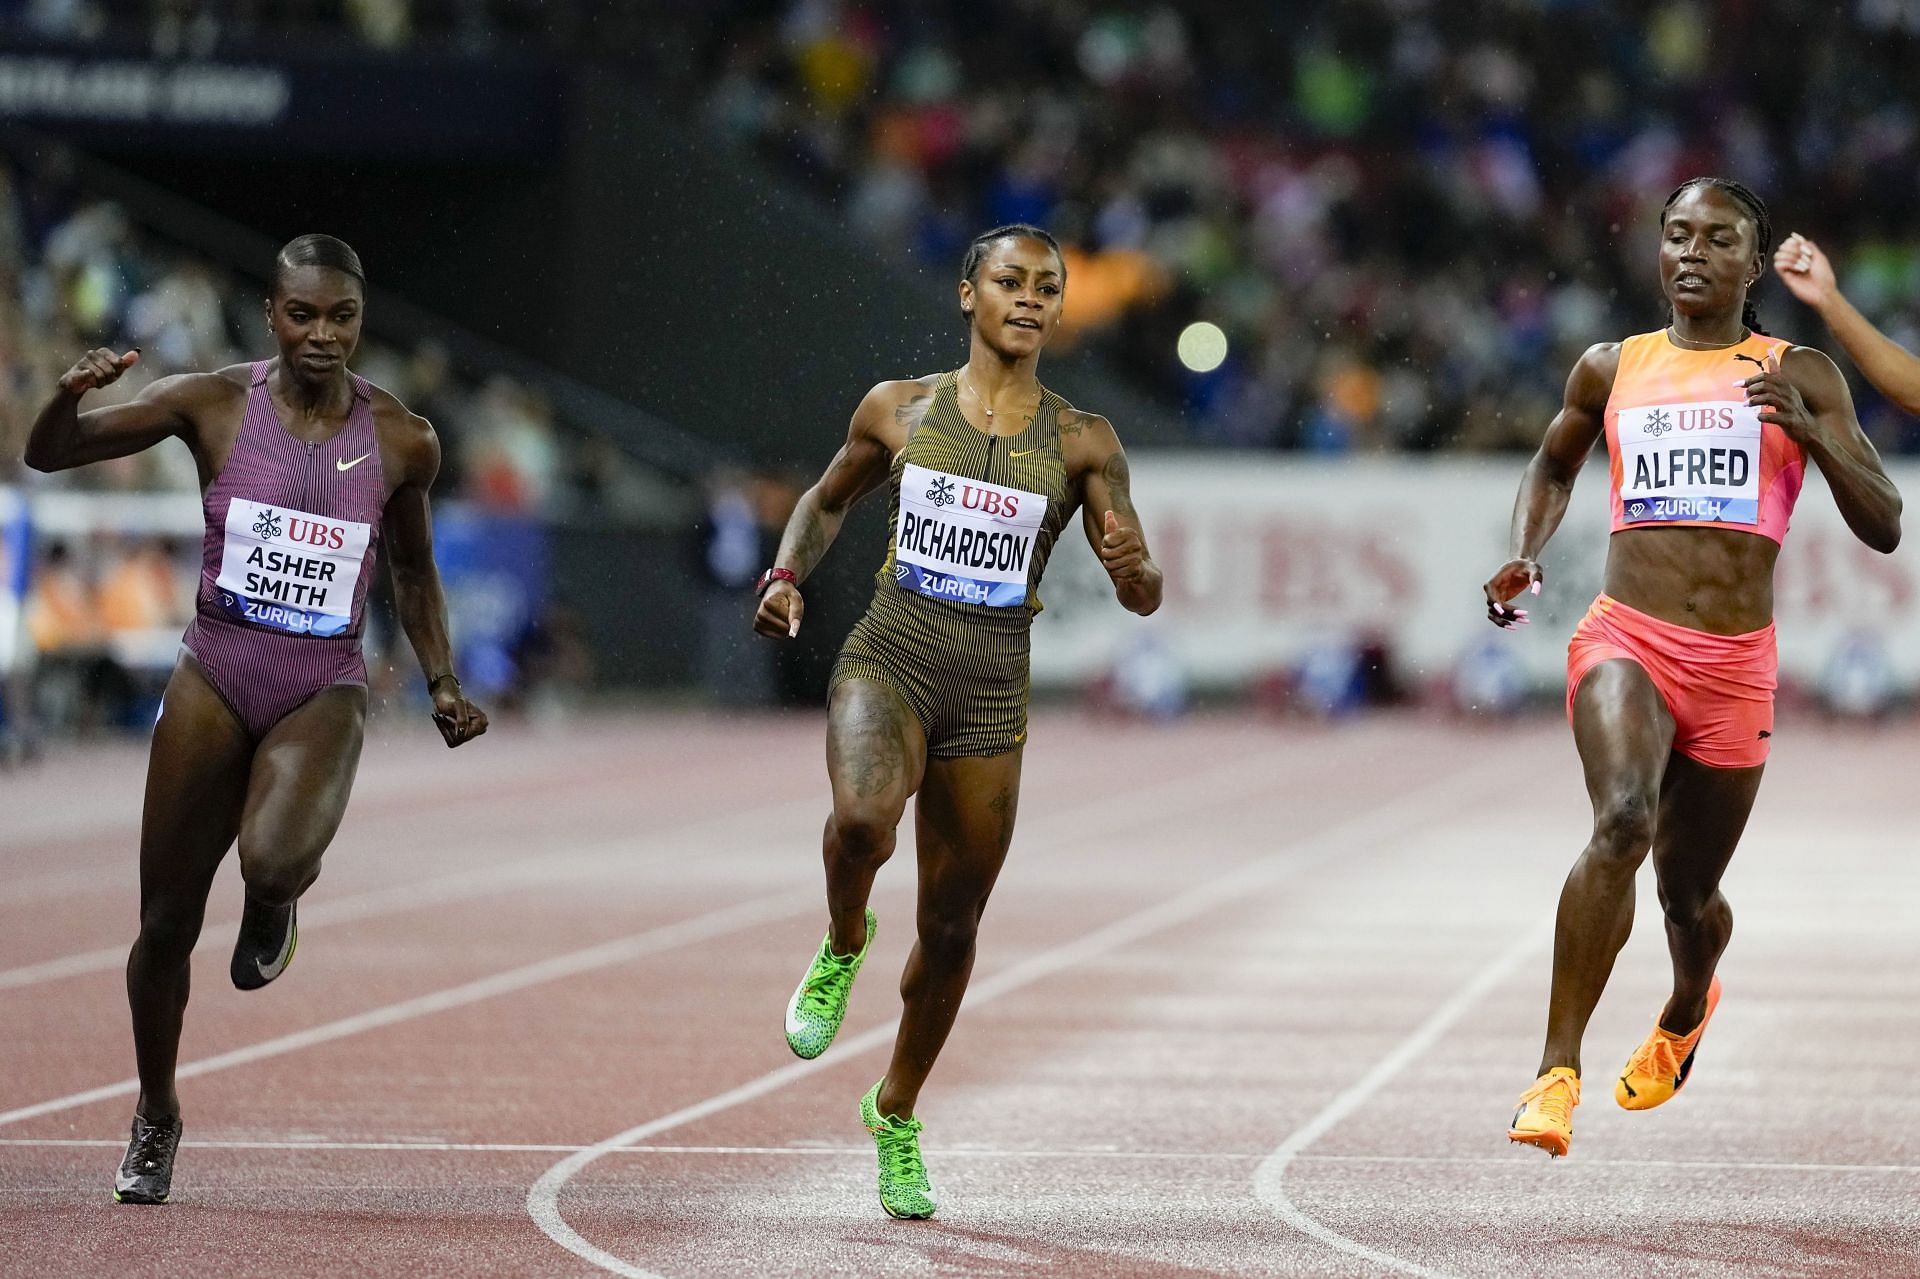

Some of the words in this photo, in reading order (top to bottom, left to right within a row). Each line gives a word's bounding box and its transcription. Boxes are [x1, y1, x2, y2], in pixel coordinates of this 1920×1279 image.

[1677, 407, 1734, 431] UBS
[1632, 448, 1749, 490] ALFRED
[961, 485, 1019, 518] UBS
[1654, 500, 1721, 516] ZURICH
[288, 517, 345, 550] UBS
[898, 511, 1029, 572] RICHARDSON
[246, 546, 336, 582] ASHER
[245, 572, 328, 607] SMITH
[920, 573, 990, 601] ZURICH
[244, 603, 313, 630] ZURICH
